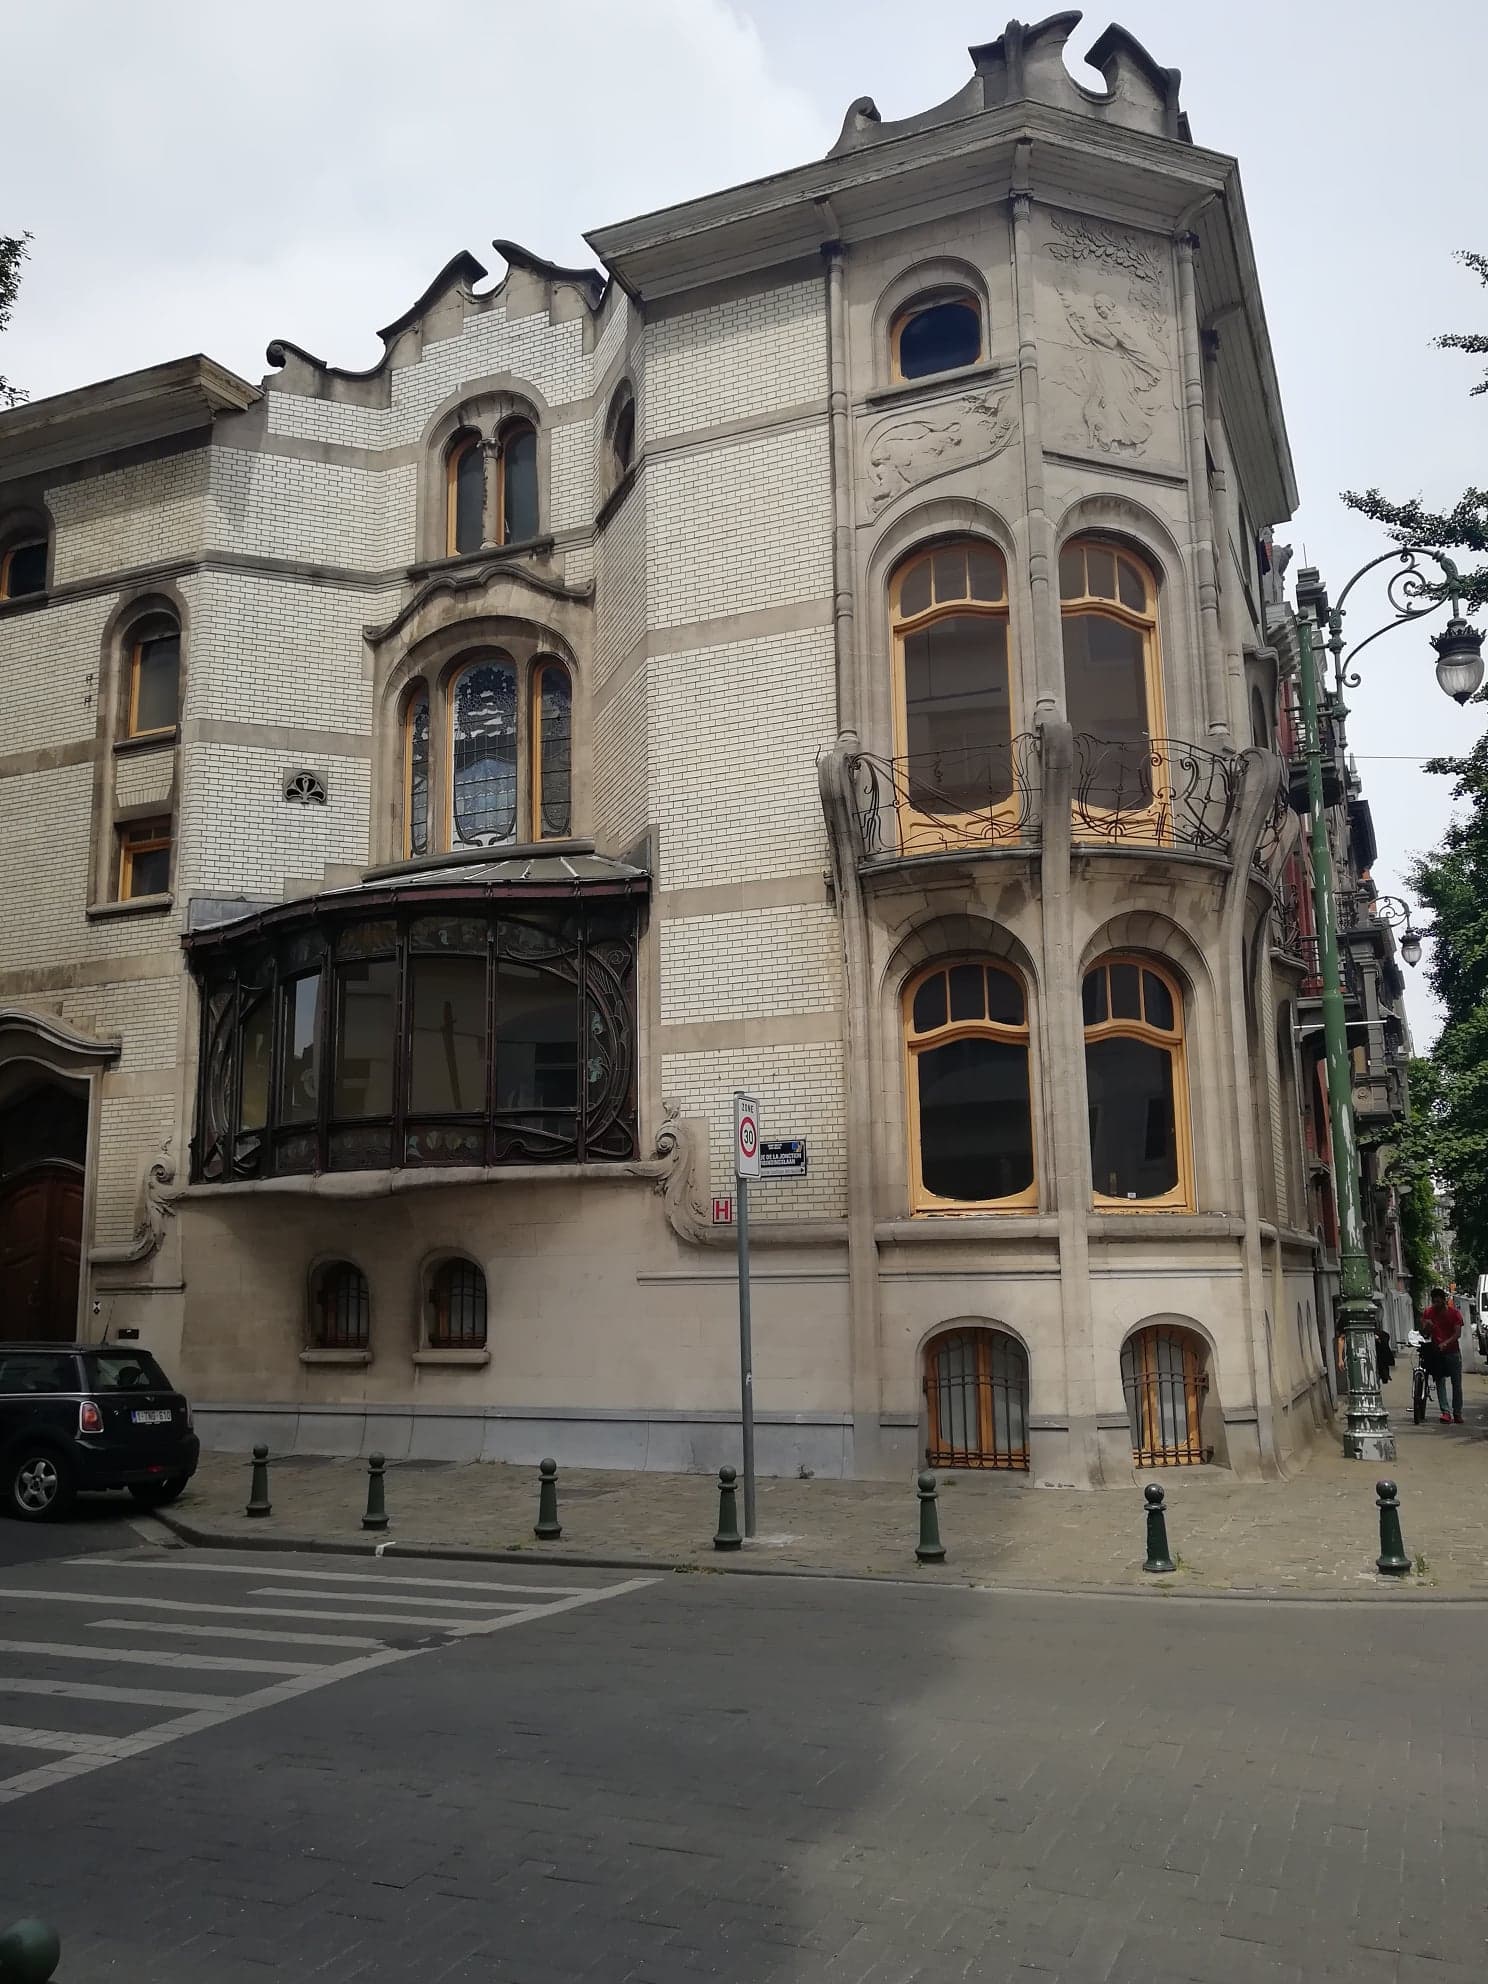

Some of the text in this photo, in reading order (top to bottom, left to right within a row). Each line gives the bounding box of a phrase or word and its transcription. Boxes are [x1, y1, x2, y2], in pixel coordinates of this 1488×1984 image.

[741, 1103, 754, 1113] ZONE
[743, 1129, 754, 1145] 30
[779, 1152, 802, 1160] JONCTION
[715, 1200, 729, 1220] H
